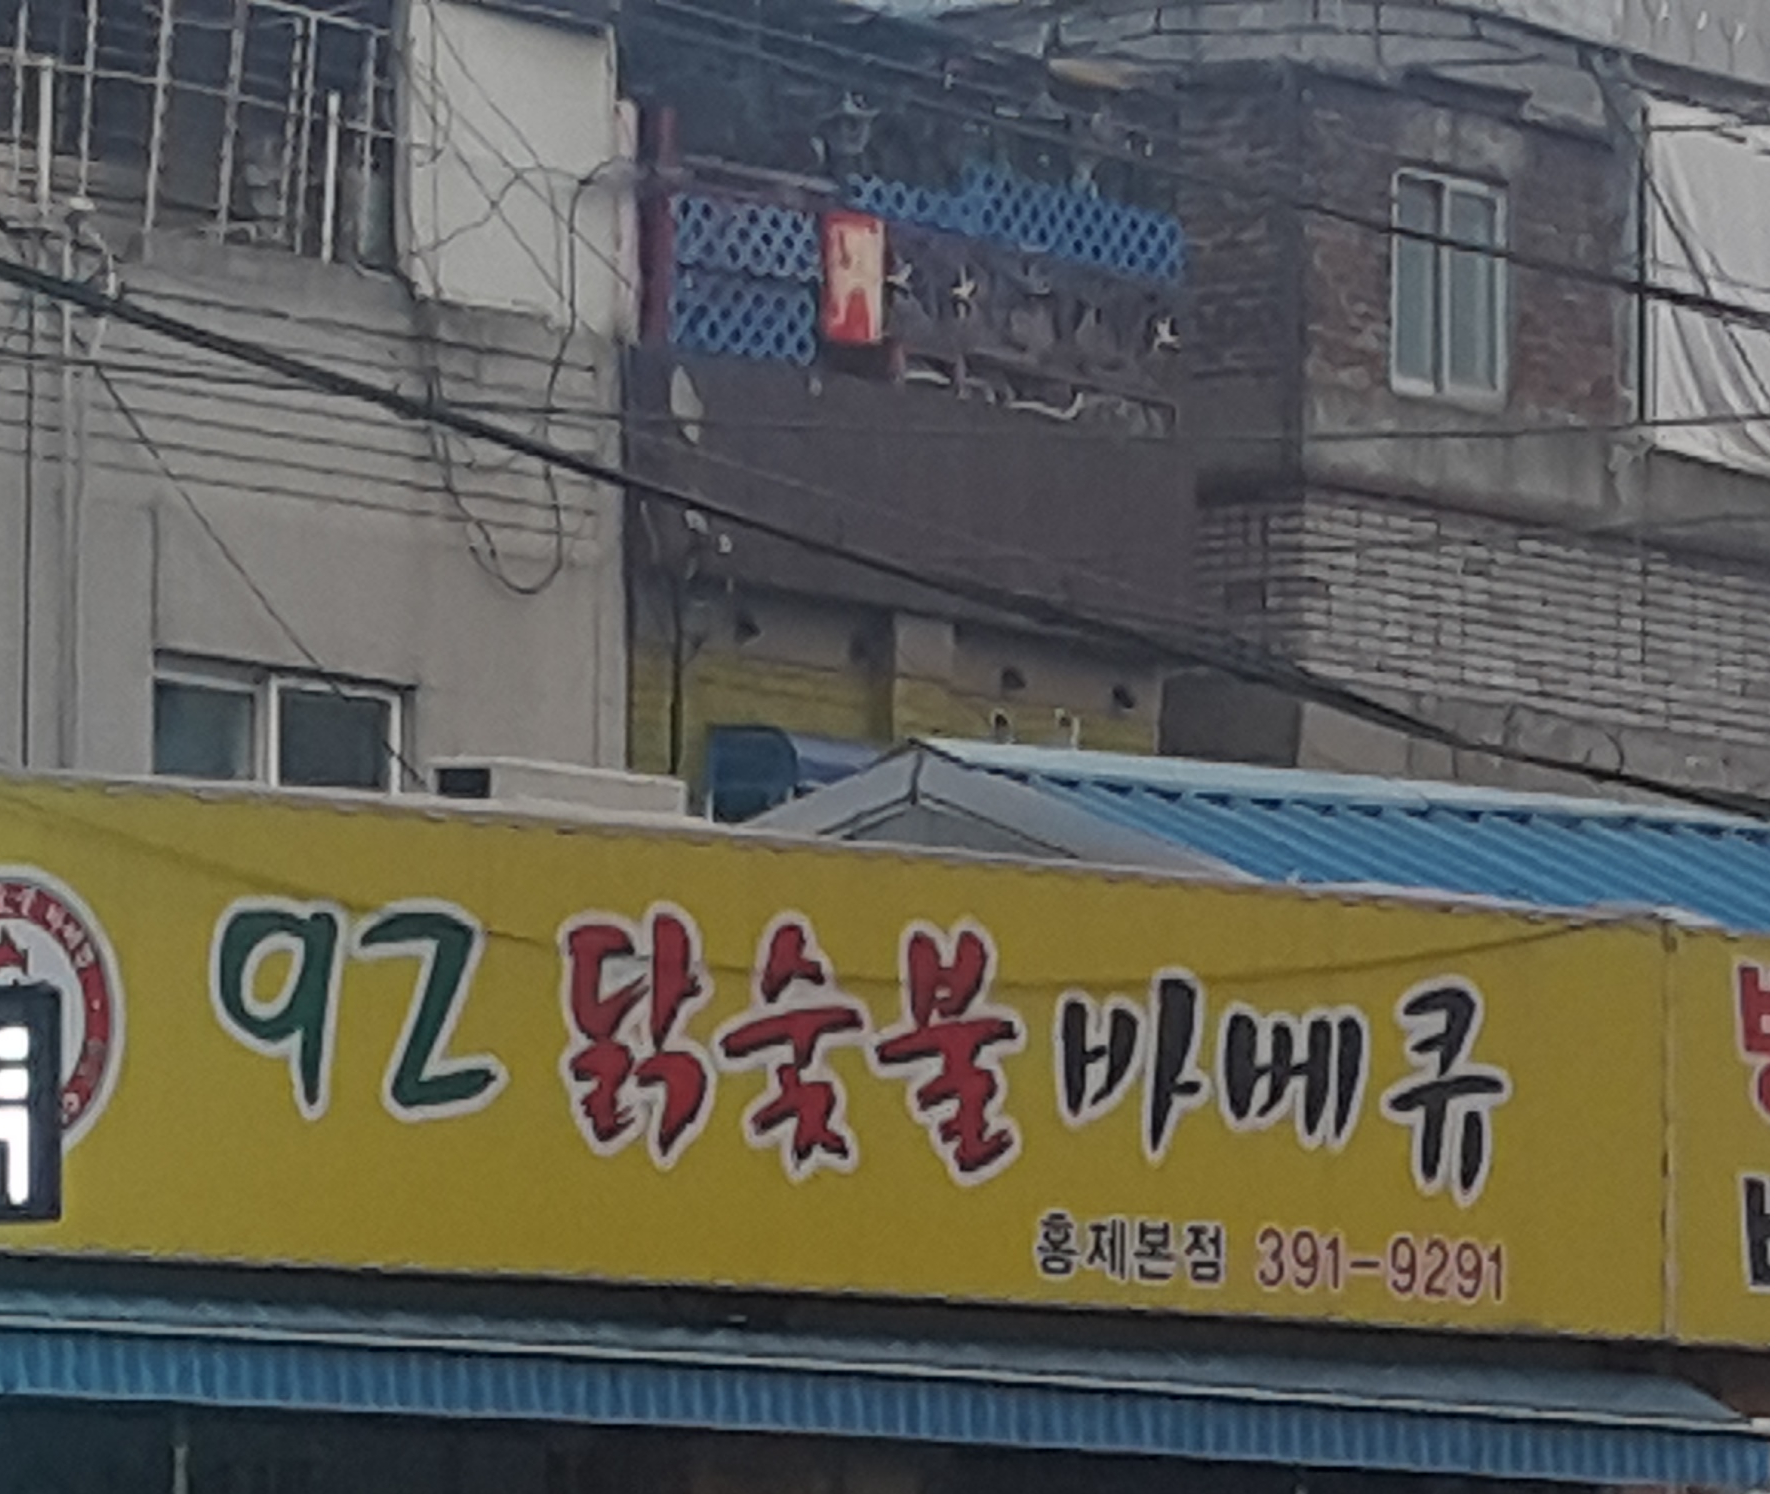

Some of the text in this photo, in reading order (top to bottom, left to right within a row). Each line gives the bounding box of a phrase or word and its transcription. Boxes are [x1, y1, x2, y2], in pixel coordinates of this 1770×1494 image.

[220, 908, 501, 1108] 92
[1059, 975, 1505, 1194] 바베큐
[1036, 1212, 1505, 1301] 홍제본점 391-9291
